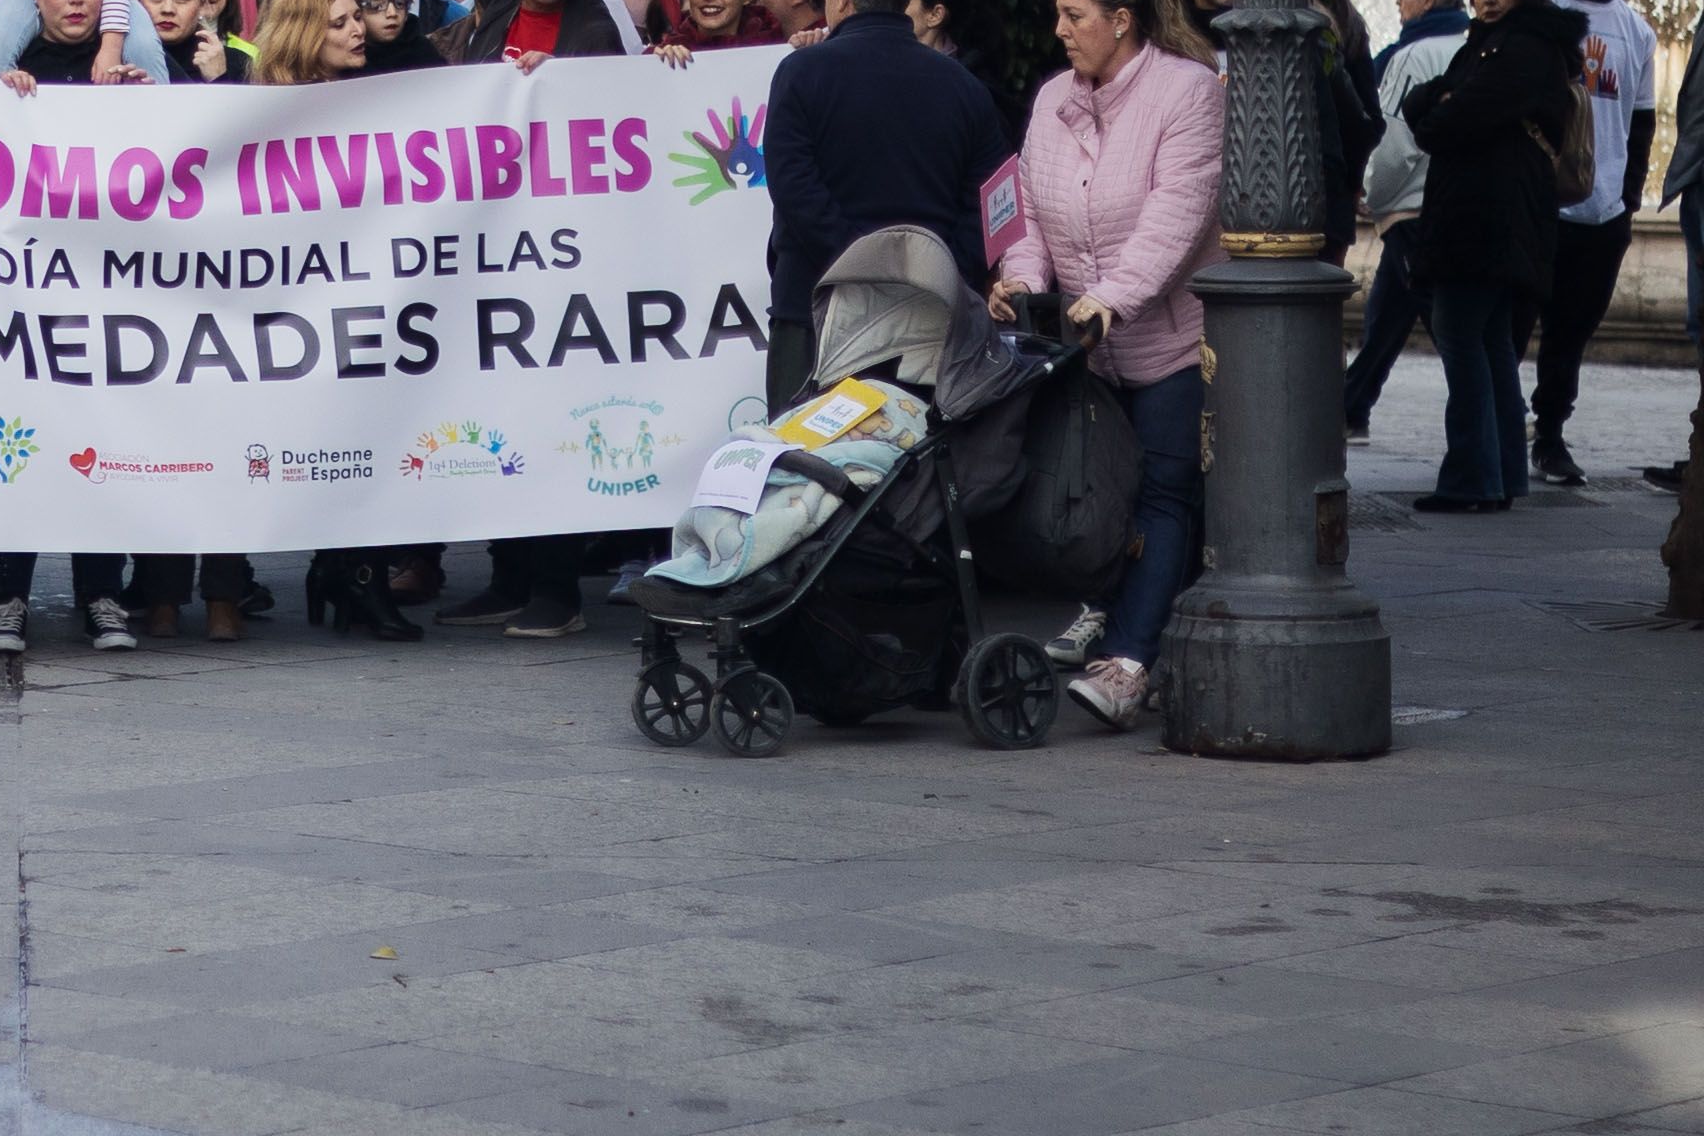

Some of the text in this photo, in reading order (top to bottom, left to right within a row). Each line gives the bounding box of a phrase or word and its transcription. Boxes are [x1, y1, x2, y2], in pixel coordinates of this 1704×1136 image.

[236, 117, 653, 217] INVISIBLES
[103, 240, 371, 290] MUNDIAL
[390, 234, 460, 280] DE
[477, 227, 583, 274] LAS
[813, 414, 845, 430] UNIPER
[281, 448, 374, 466] Duchenne
[449, 458, 497, 470] Deletions
[99, 461, 215, 474] MARCOS CARRIBERO
[310, 464, 374, 484] España
[587, 473, 661, 496] UNIPER
